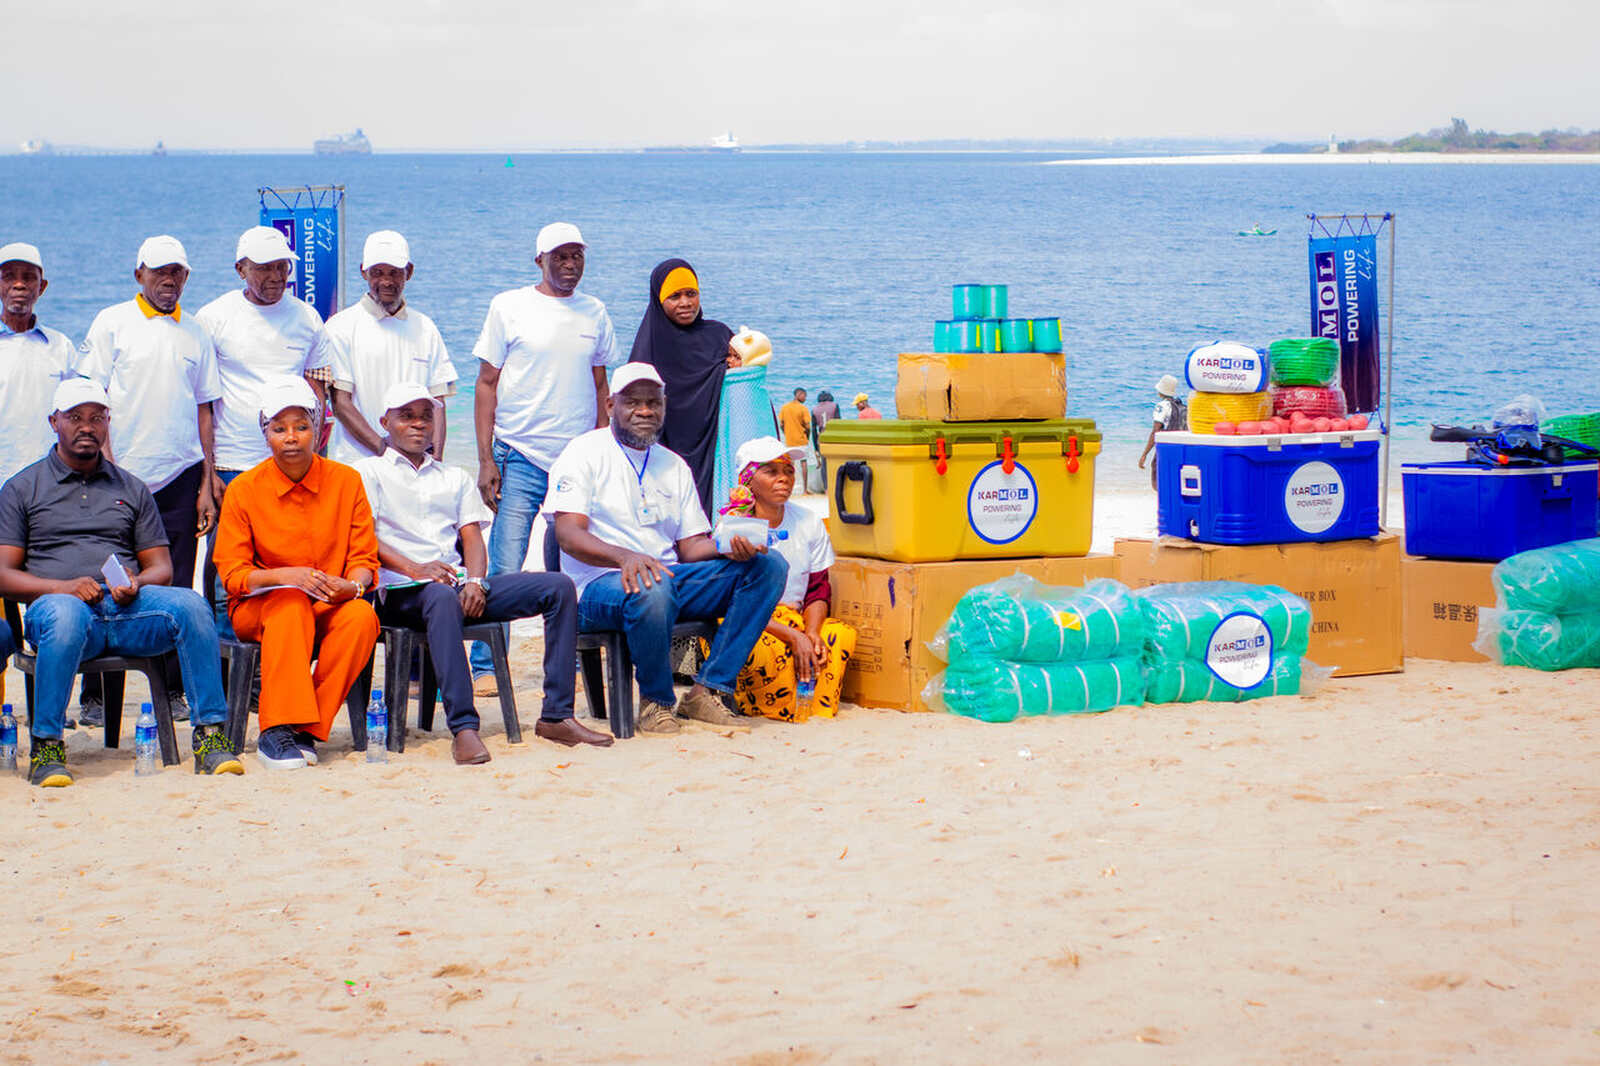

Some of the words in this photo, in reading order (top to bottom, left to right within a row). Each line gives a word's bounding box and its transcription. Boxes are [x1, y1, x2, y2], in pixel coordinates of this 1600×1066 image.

[304, 217, 315, 305] OWERING
[1344, 249, 1360, 342] POWERING
[1197, 358, 1254, 370] KARMOL
[1202, 371, 1247, 381] POWERING
[978, 488, 1028, 501] KARMOL
[1291, 483, 1338, 496] KARMOL
[983, 504, 1022, 512] POWERING
[1319, 590, 1337, 601] BOX
[1311, 621, 1340, 633] CHINA
[1214, 635, 1264, 652] KARMOL
